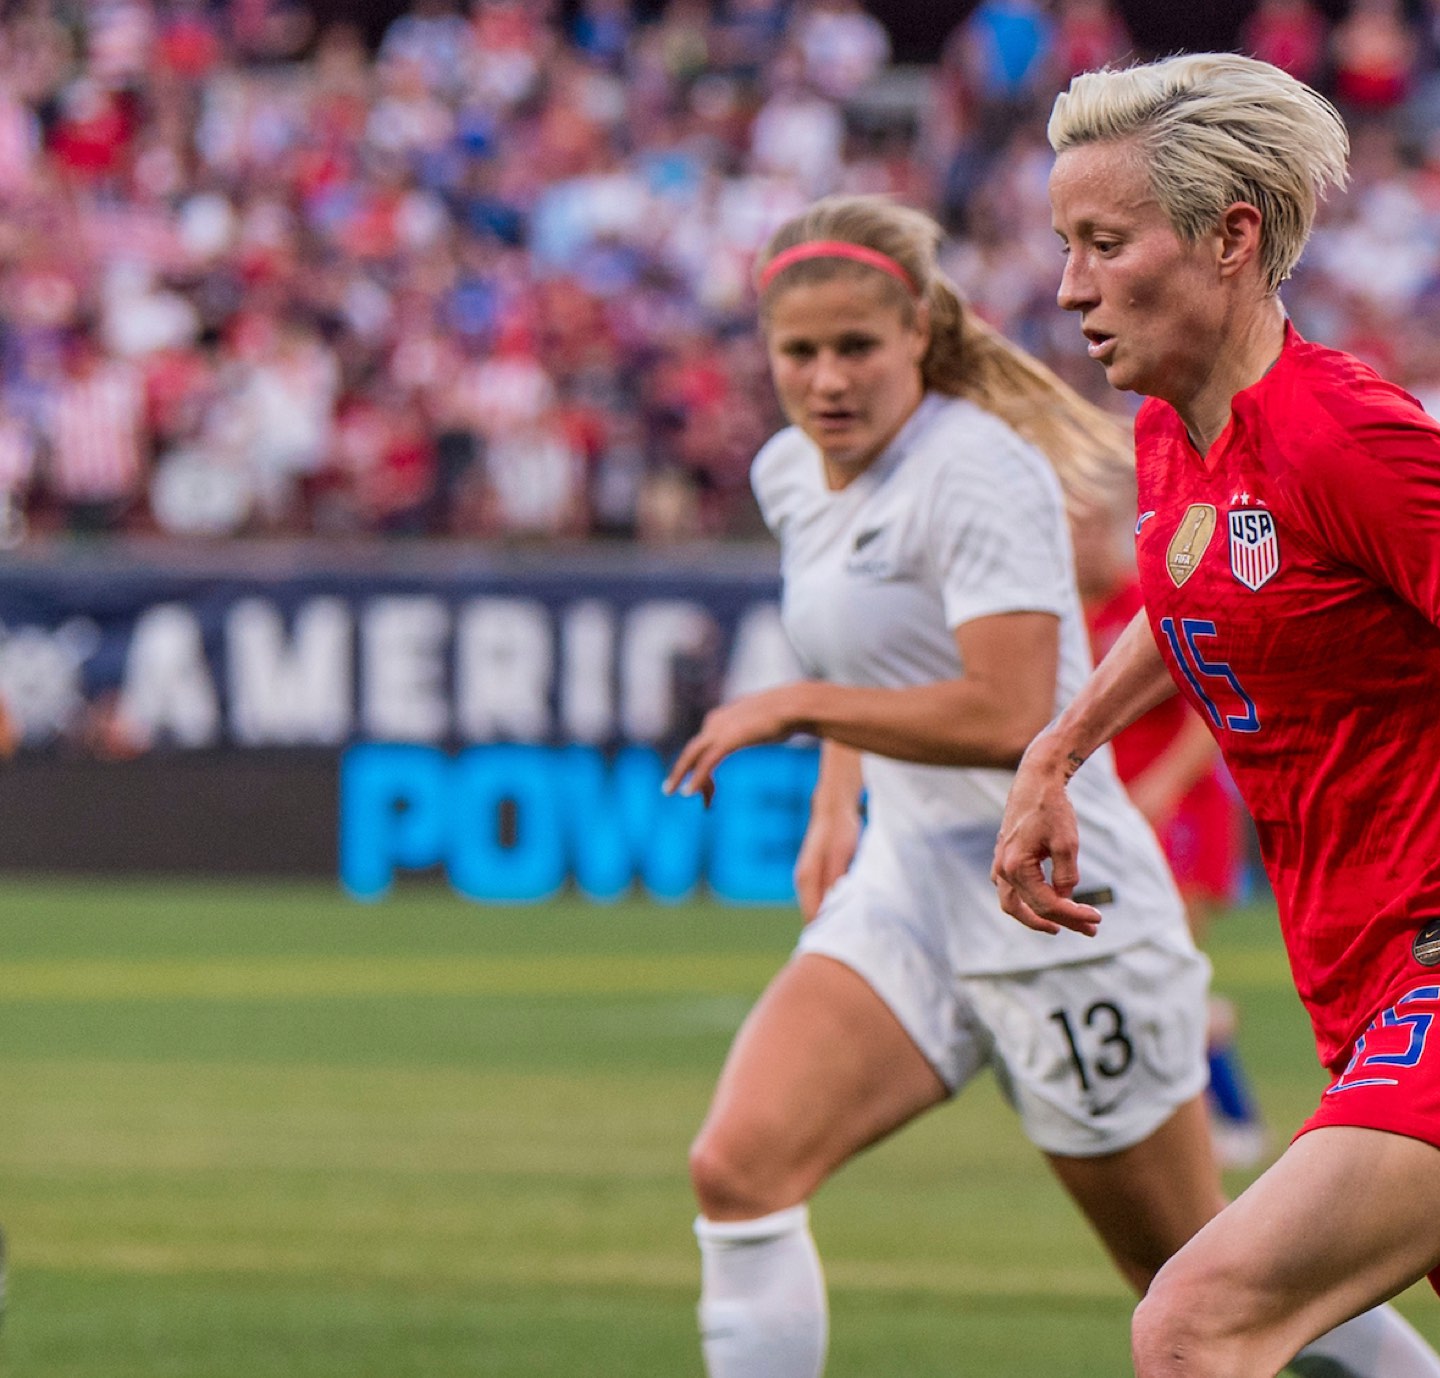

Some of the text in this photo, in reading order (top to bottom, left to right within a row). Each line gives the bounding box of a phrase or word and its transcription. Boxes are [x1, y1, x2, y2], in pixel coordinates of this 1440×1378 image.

[1232, 514, 1273, 544] USA
[1160, 616, 1262, 733] 15
[338, 741, 868, 905] POWE
[1049, 1001, 1134, 1092] 13
